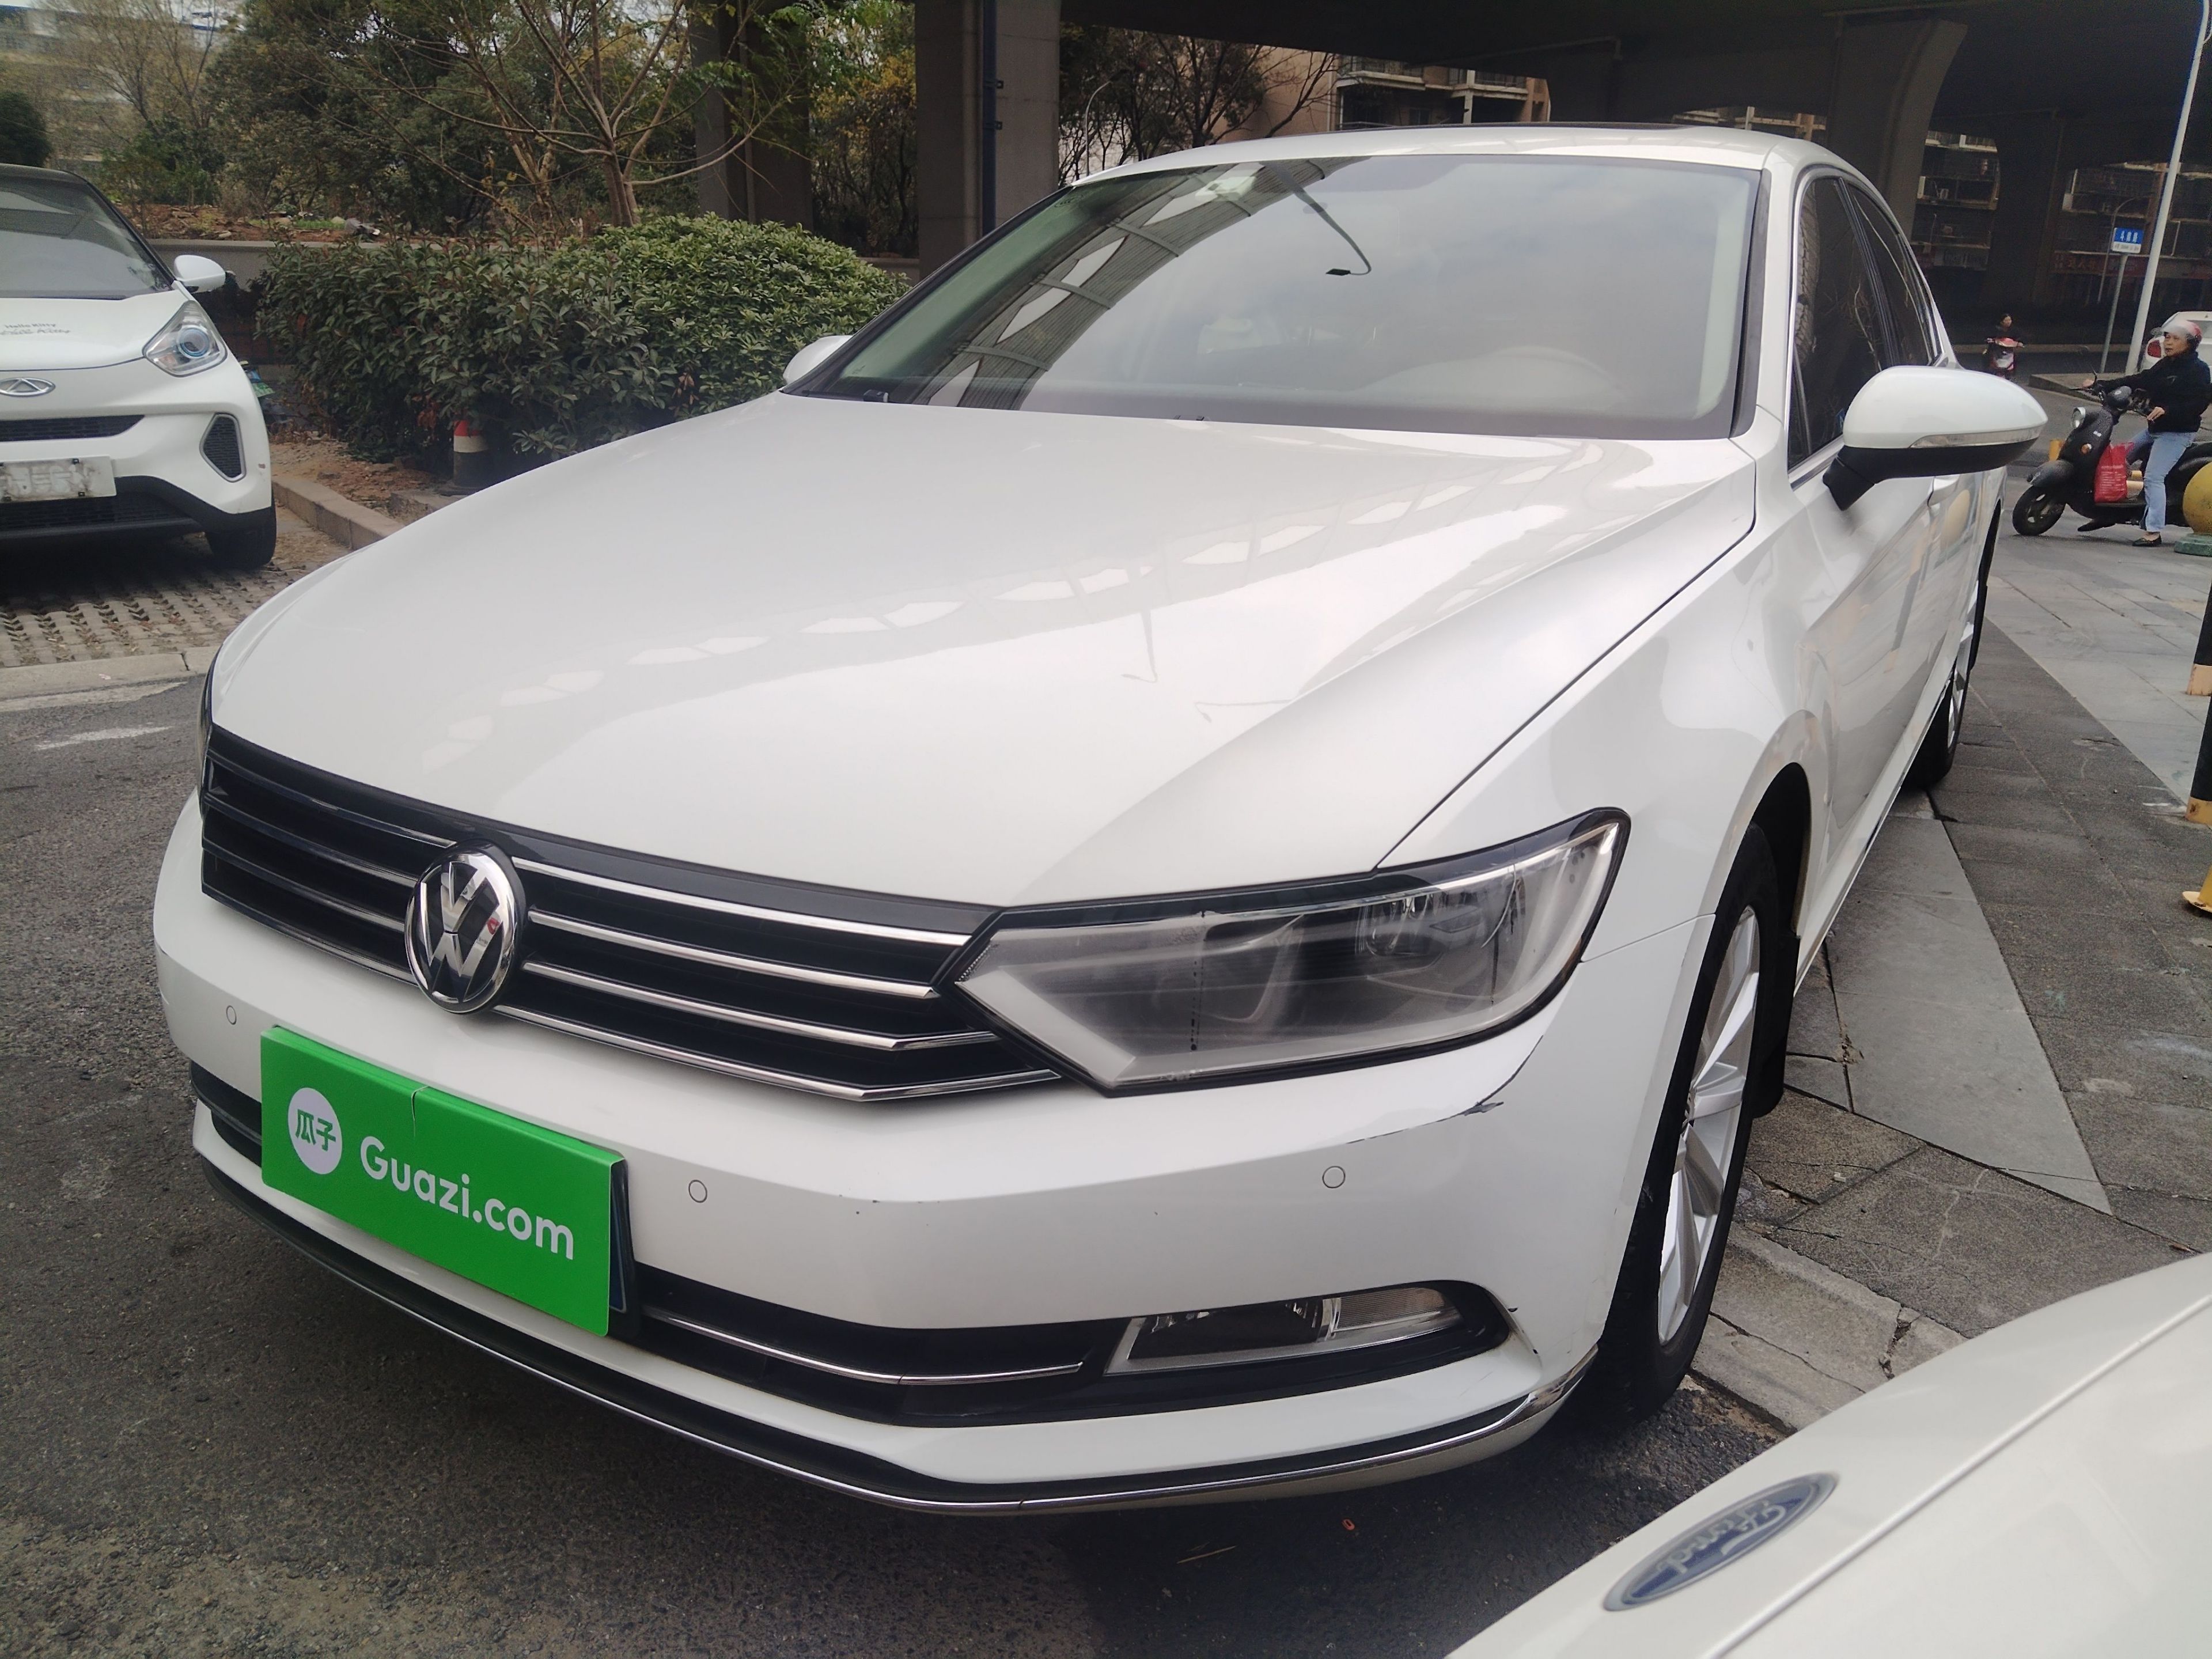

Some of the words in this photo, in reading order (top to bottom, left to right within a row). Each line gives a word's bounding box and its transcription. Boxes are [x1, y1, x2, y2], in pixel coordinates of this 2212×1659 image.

[295, 1109, 336, 1152] 瓜子
[360, 1136, 574, 1260] Guazi.com
[1654, 1499, 1787, 1575] Ford
